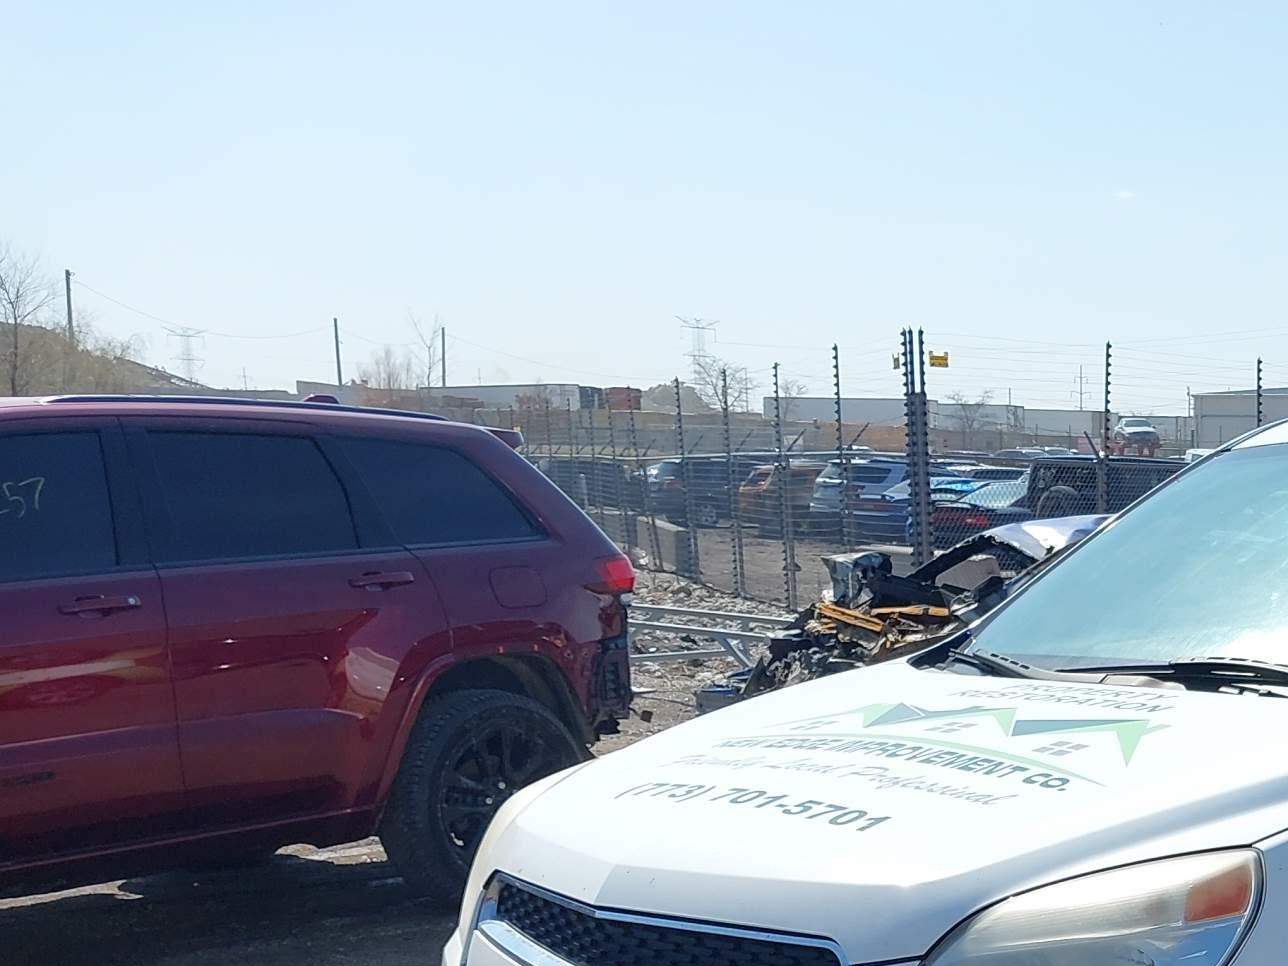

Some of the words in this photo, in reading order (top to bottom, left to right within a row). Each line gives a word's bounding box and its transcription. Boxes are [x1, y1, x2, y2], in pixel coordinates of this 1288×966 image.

[0, 477, 45, 518] 57
[949, 690, 1175, 713] RESTORATION
[1001, 684, 1179, 701] PROPERTY
[824, 739, 1029, 778] IMPROVEMENT
[1022, 773, 1070, 792] CO.
[614, 783, 716, 803] (773)
[709, 788, 892, 831] 701-5701
